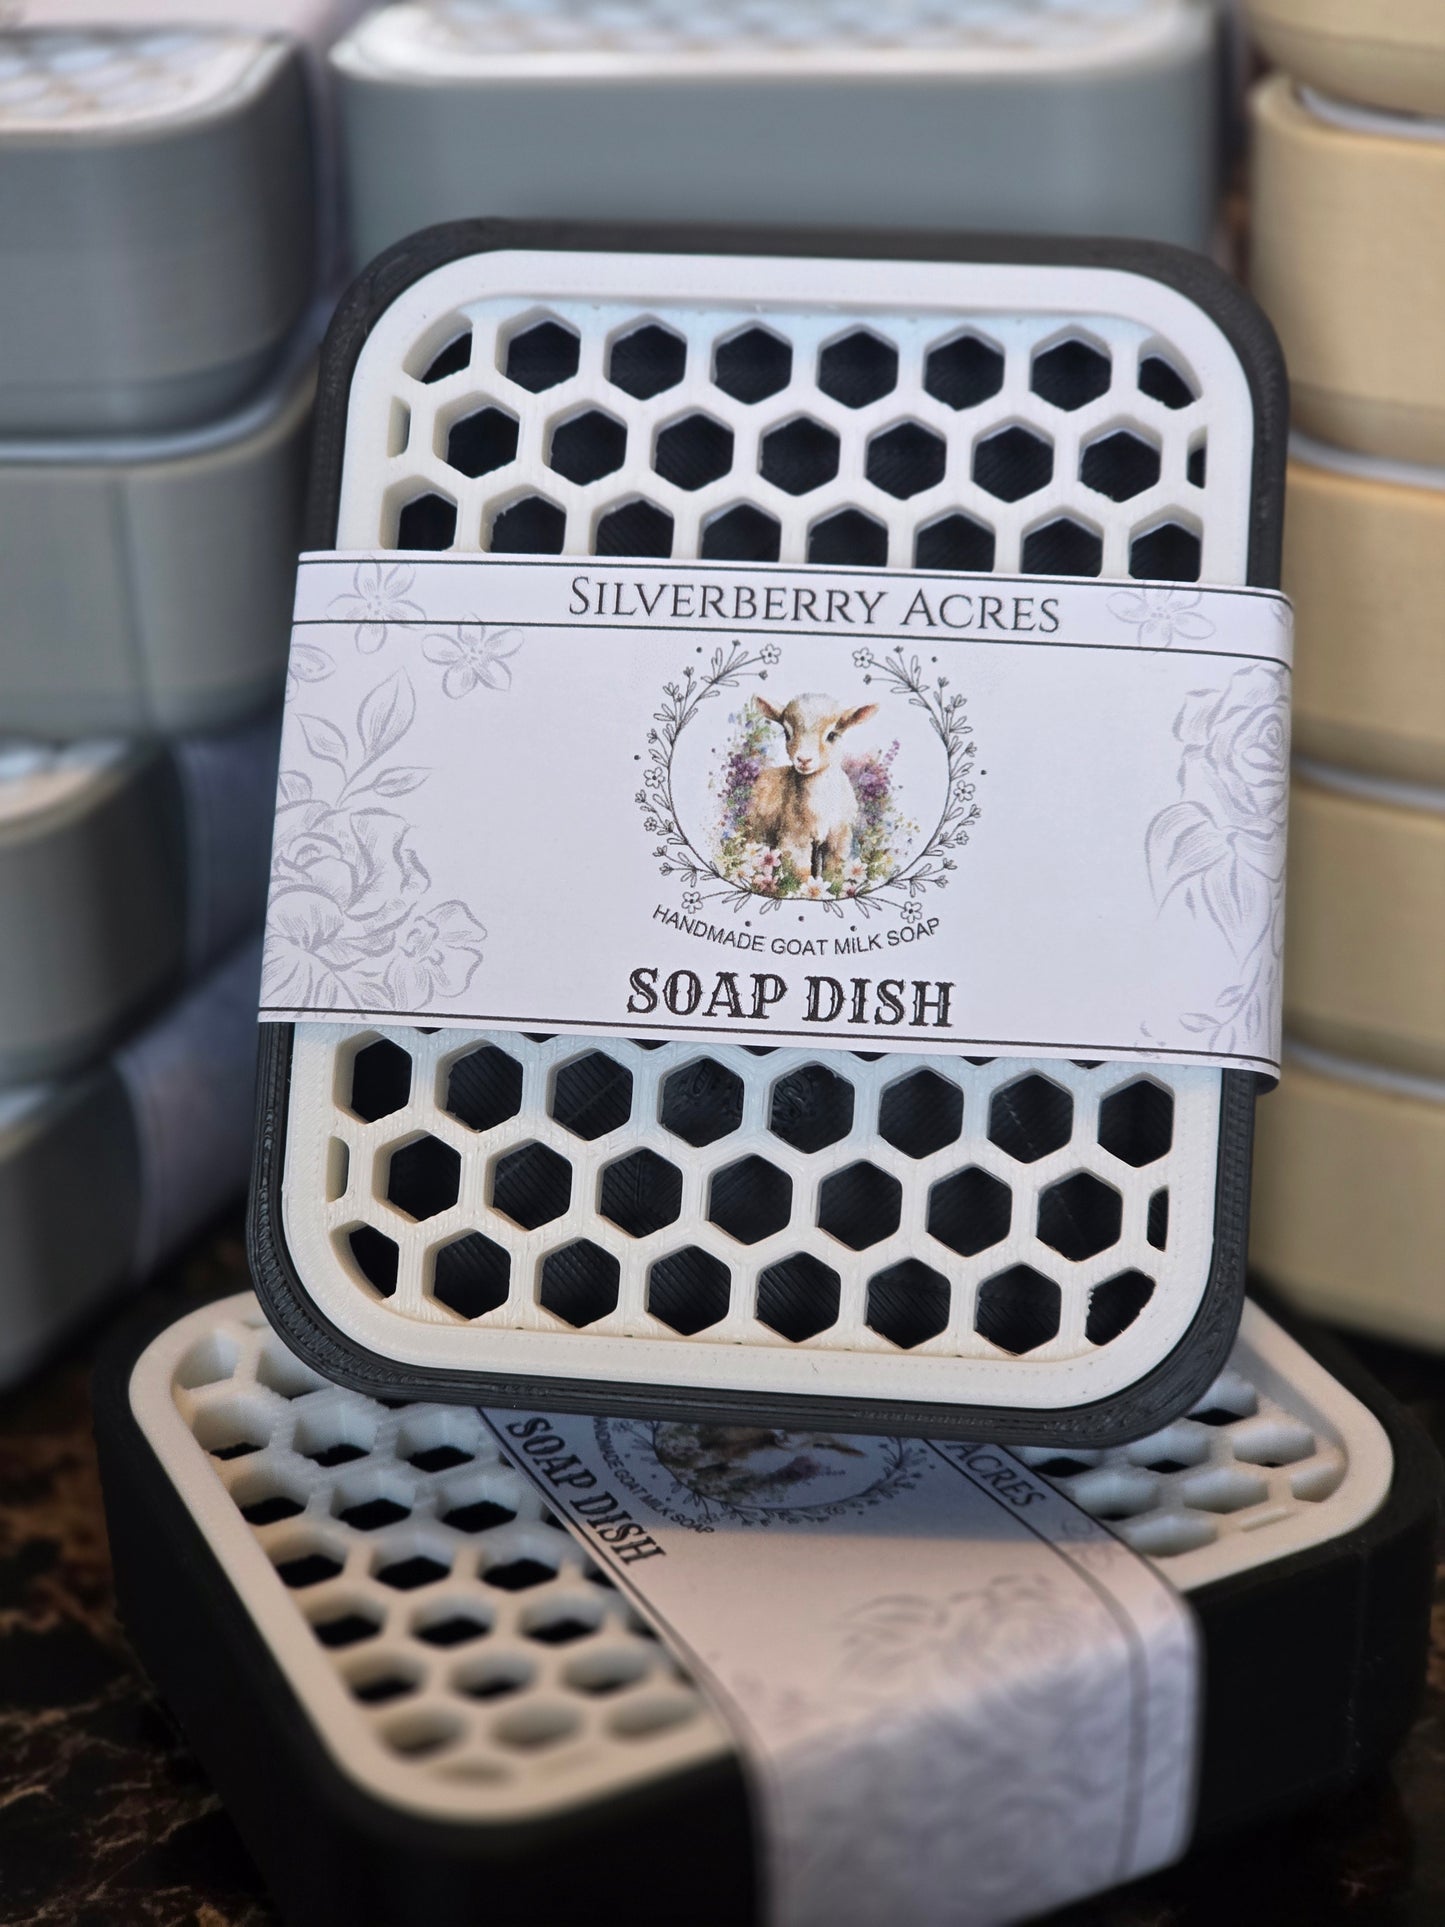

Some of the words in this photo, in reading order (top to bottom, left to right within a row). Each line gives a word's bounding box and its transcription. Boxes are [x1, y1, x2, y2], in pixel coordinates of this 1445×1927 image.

[568, 575, 890, 624] SILVERBERRY
[899, 588, 1061, 634] ACRES
[652, 904, 767, 952] HANDMADE
[771, 937, 828, 956] GOAT
[834, 933, 883, 955] MILK
[887, 917, 940, 947] SOAP
[626, 967, 788, 1020] SOAP
[801, 974, 956, 1028] DISH
[505, 1416, 598, 1489] SOAP
[569, 1490, 667, 1566] DISH
[614, 1468, 649, 1495] GOAT
[670, 1512, 715, 1534] SOAP
[944, 1443, 1047, 1508] ACRES
